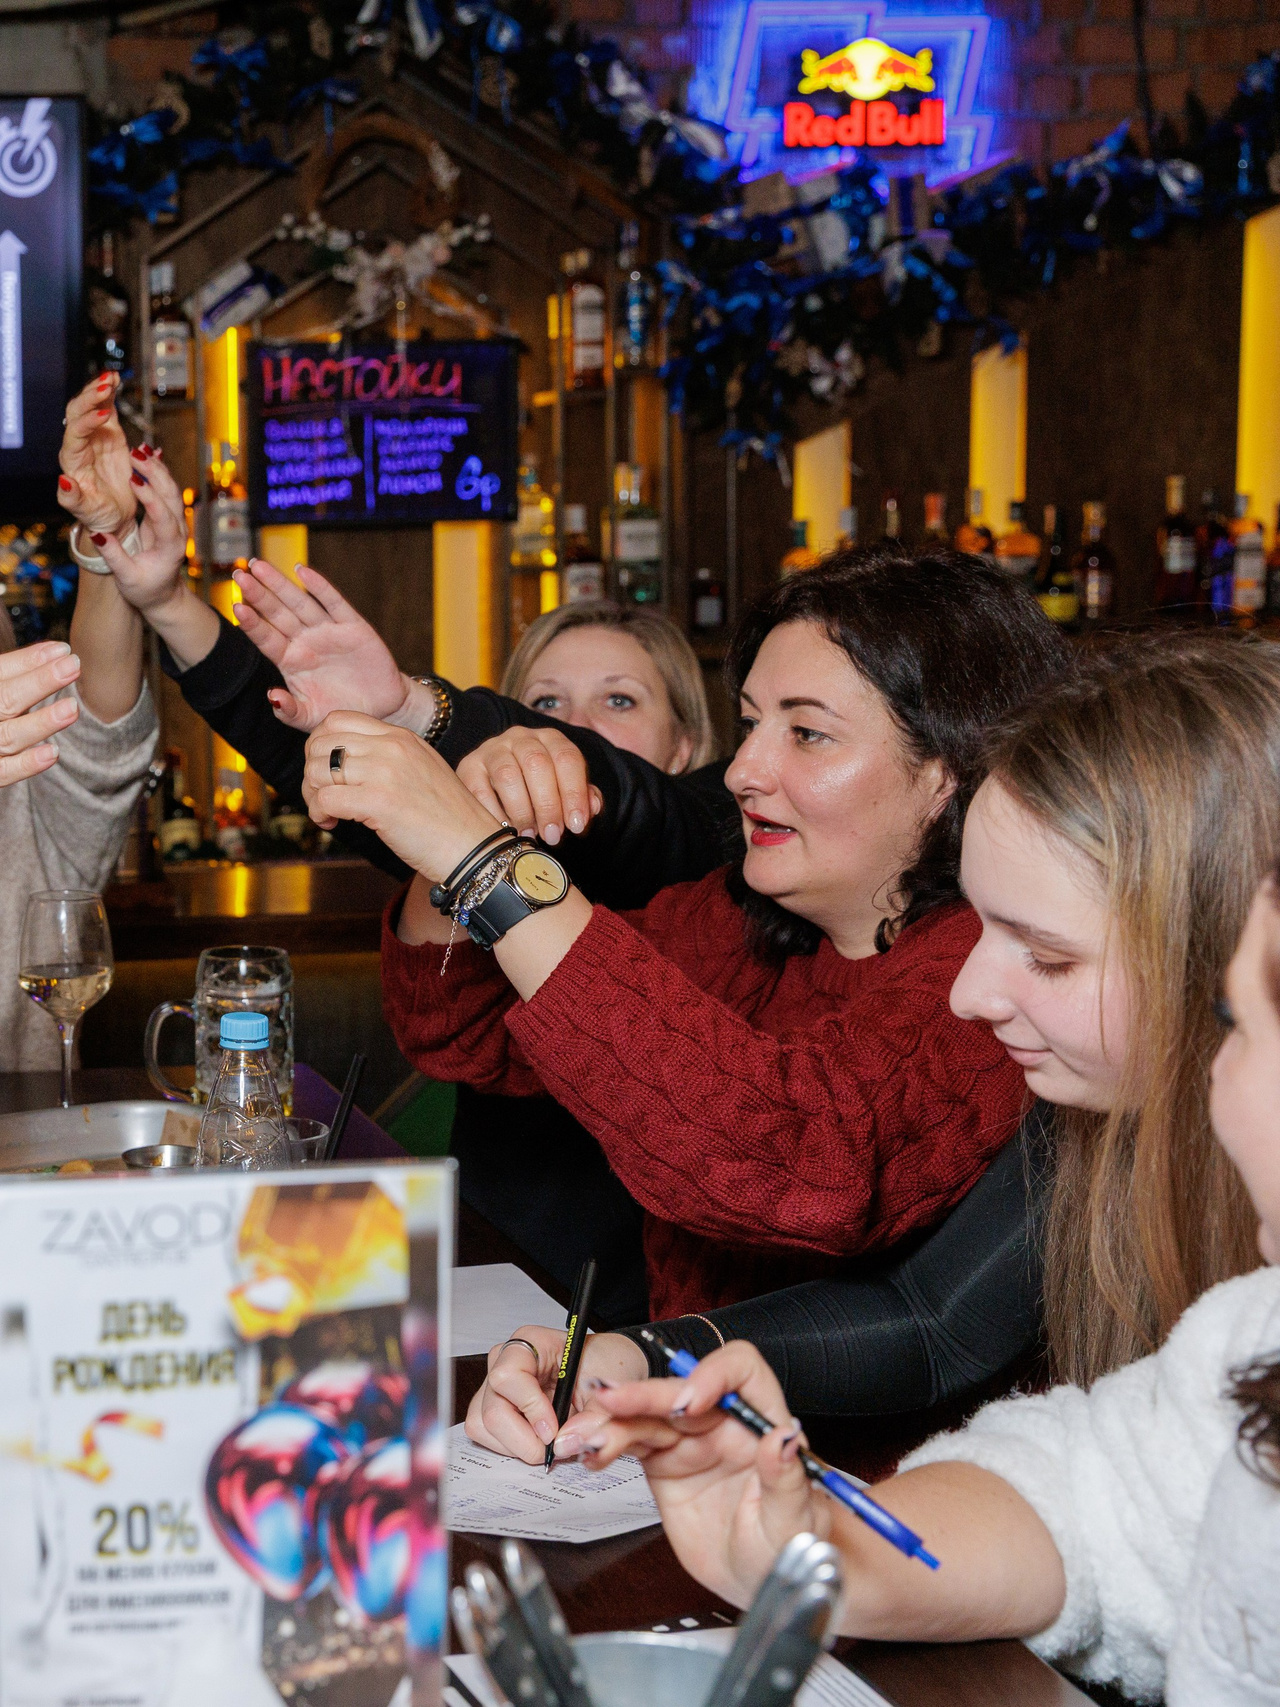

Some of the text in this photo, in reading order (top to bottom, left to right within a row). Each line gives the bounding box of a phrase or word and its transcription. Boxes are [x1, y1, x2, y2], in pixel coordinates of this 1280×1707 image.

[784, 98, 945, 147] Red Bull
[262, 354, 462, 405] НАСТОЙКИ
[39, 1202, 232, 1254] ZAVOD
[100, 1302, 186, 1341] ДЕНЬ
[561, 1314, 578, 1370] МАМАКВИЗ!
[53, 1350, 236, 1393] РОЖДЕНИЯ
[92, 1502, 200, 1560] 20%
